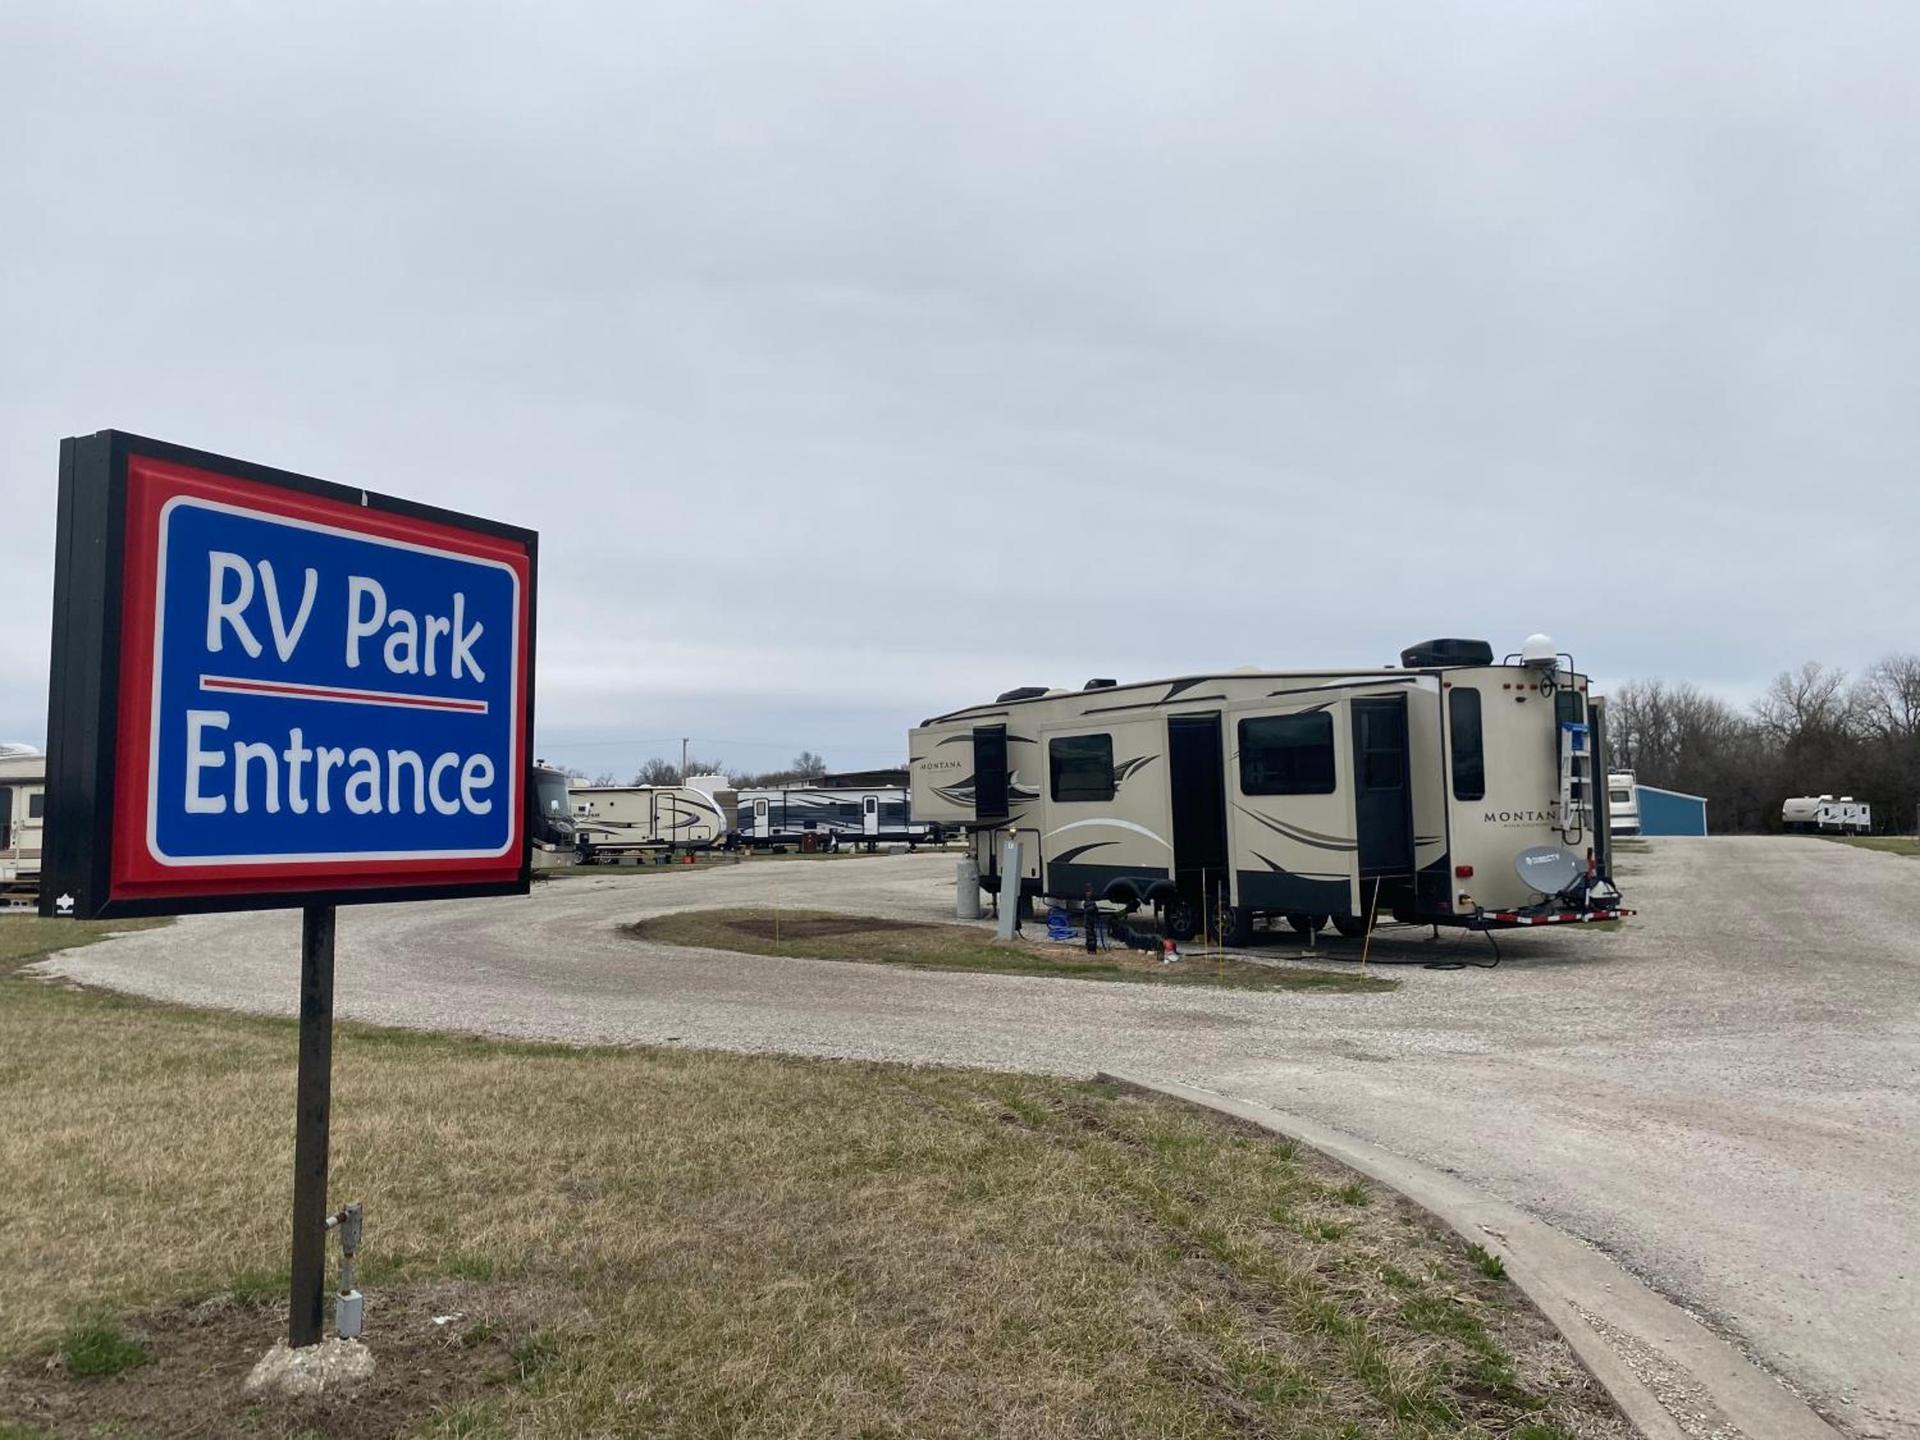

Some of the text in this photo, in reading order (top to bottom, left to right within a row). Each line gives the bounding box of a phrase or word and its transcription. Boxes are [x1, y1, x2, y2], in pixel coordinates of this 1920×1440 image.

[206, 550, 485, 683] RV Park
[184, 709, 495, 815] Entrance
[920, 761, 962, 770] MONTANA
[1484, 811, 1558, 822] MONTAN
